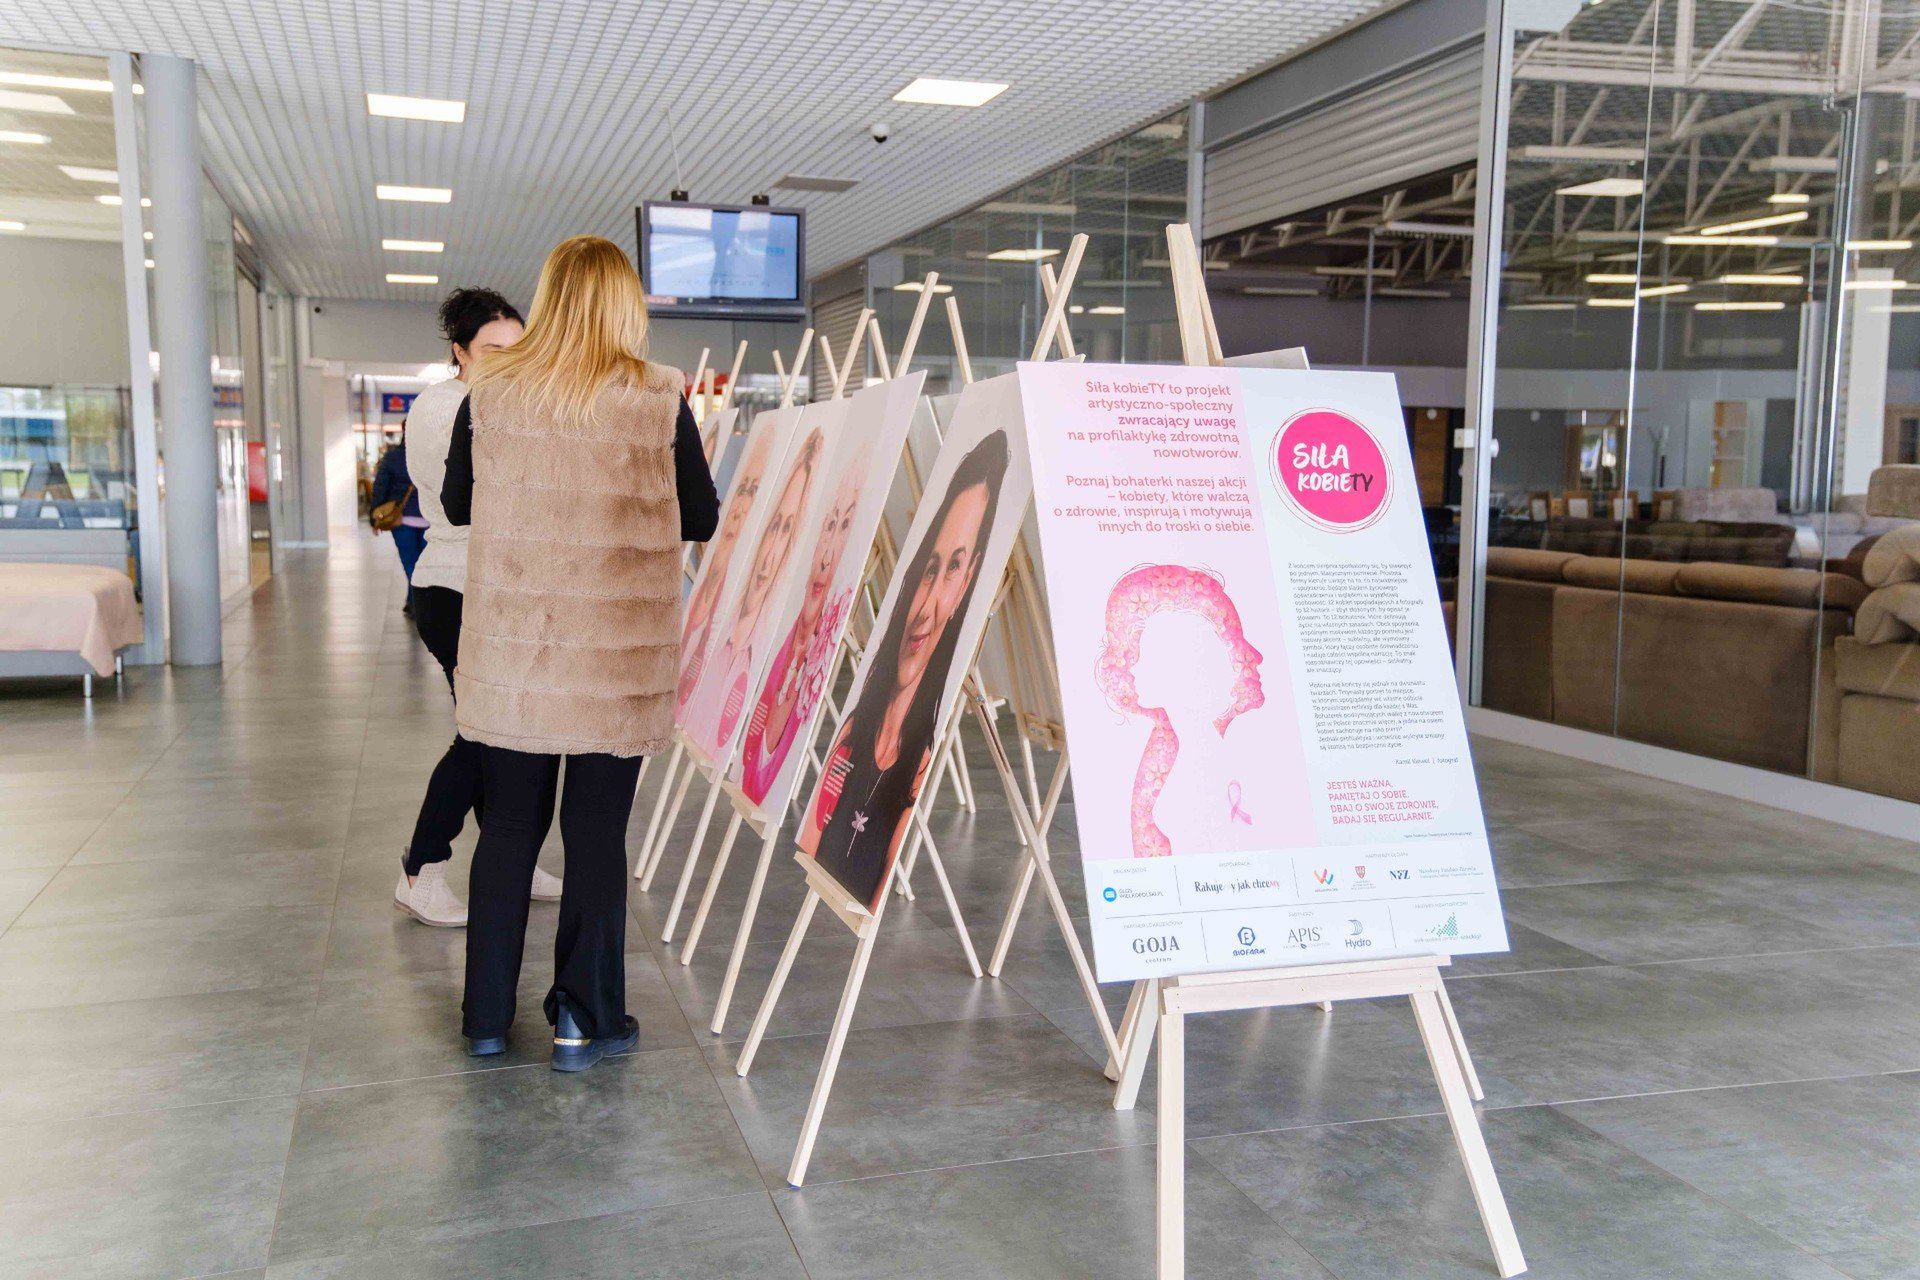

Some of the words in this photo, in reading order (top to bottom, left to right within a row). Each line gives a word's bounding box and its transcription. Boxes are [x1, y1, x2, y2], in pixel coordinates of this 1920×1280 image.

[1086, 382, 1110, 393] Siła
[1114, 382, 1165, 394] kobieTY
[1170, 385, 1182, 395] to
[1186, 385, 1231, 397] projekt
[1088, 399, 1233, 412] artystyczno-społeczny
[1118, 416, 1189, 428] zwracający
[1194, 418, 1236, 428] uwagę
[1068, 431, 1085, 440] na
[1089, 431, 1167, 443] profilaktykę
[1171, 432, 1240, 444] zdrowotną
[1154, 449, 1241, 459] nowotworów.
[1292, 442, 1350, 470] SIŁA
[1066, 476, 1109, 488] Poznaj
[1113, 476, 1173, 487] bohaterki
[1176, 477, 1214, 488] naszej
[1218, 477, 1247, 488] akcji
[1297, 472, 1374, 492] KOBIETY
[1119, 491, 1168, 503] kobiety,
[1172, 492, 1203, 502] które
[1207, 492, 1250, 504] walczą
[1054, 508, 1062, 516] o
[1066, 507, 1121, 518] zdrowie,
[1124, 507, 1179, 518] inspirują
[1191, 508, 1252, 518] motywują
[1098, 522, 1141, 533] innych
[1146, 522, 1162, 531] do
[1166, 522, 1200, 532] troski
[1216, 522, 1254, 532] siebie.
[1327, 780, 1357, 789] JESTEŚ
[1328, 793, 1370, 801] PAMIĘTAJ
[1331, 804, 1353, 813] DBAJ
[1365, 802, 1395, 811] SWOJE
[1332, 816, 1361, 824] BADAJ
[1363, 815, 1377, 824] SIĘ
[1379, 812, 1434, 822] REGULARNIE.
[1288, 926, 1321, 943] APIS
[1133, 935, 1180, 954] GOJA
[1345, 938, 1371, 949] Hydro
